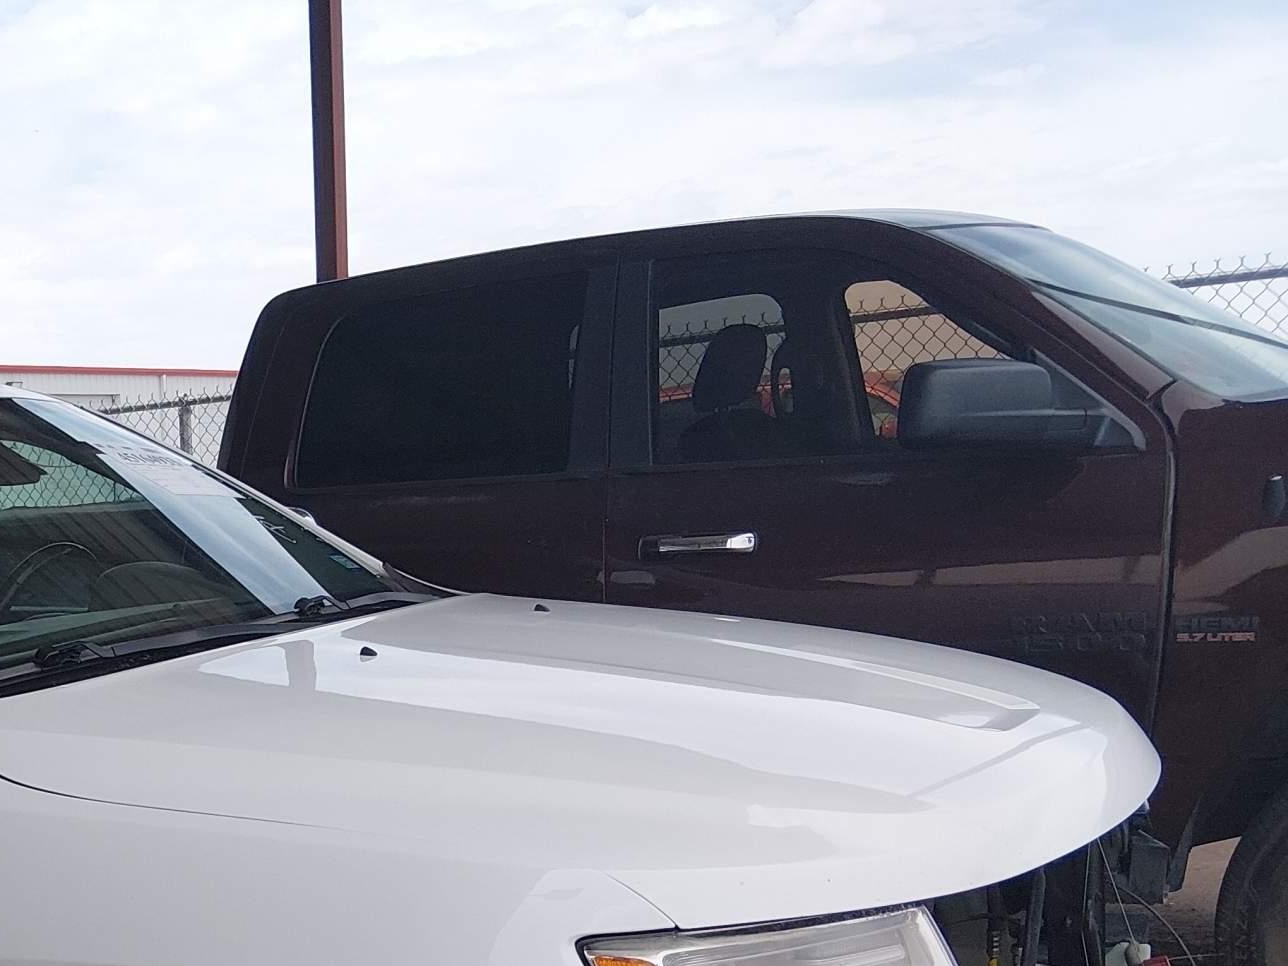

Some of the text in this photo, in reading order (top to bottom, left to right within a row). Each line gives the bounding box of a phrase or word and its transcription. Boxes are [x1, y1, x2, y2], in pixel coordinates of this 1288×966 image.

[1176, 615, 1259, 631] HEMI
[1176, 631, 1257, 643] 5.7 LITER
